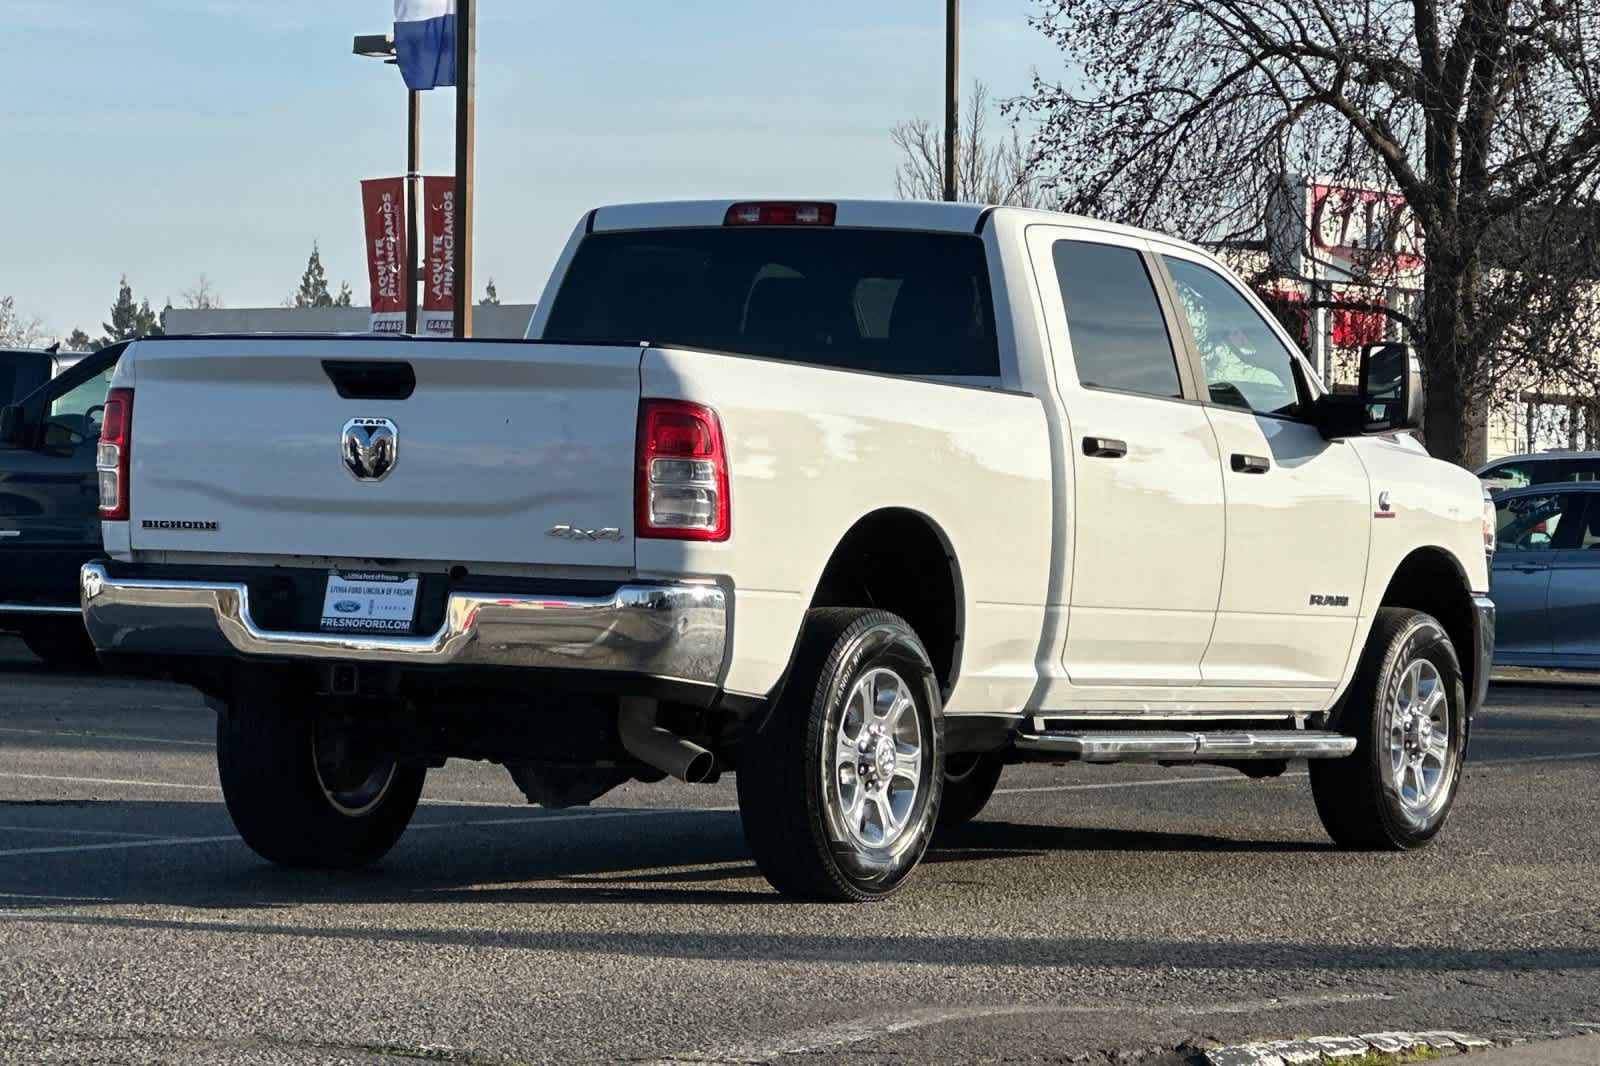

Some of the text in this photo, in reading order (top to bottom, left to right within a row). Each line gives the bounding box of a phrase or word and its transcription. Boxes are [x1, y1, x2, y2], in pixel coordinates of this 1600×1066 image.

[383, 193, 397, 297] FINANCIAMOS
[443, 191, 454, 296] FINANCIAMOS
[374, 239, 389, 297] AQUÍ TE
[430, 235, 443, 295] AQUÍ TE
[374, 321, 402, 331] GANAS
[141, 520, 218, 529] BIGHORN
[1309, 593, 1349, 606] RAM
[321, 618, 410, 630] FRESNOFORD.COM
